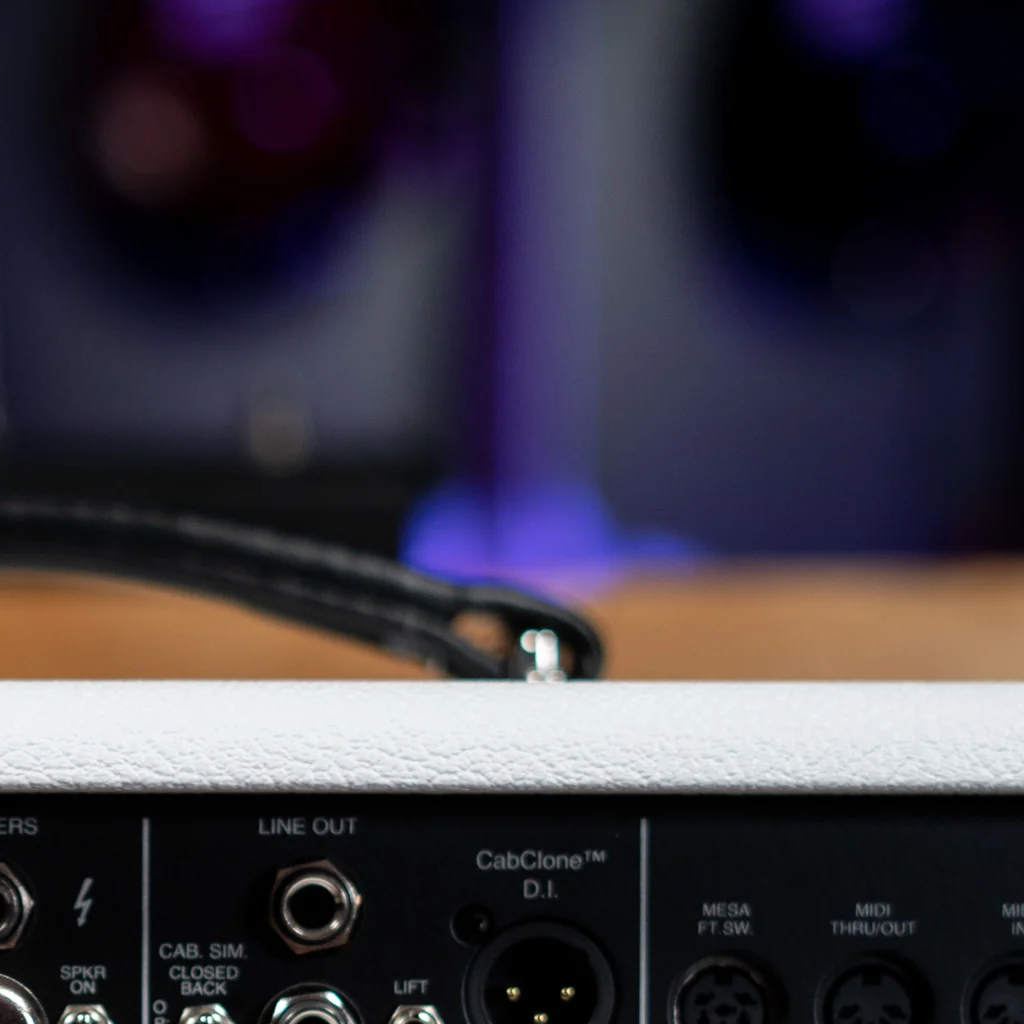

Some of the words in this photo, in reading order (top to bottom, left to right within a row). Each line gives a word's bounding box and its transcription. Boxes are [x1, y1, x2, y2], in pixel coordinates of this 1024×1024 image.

[258, 817, 306, 836] LINE
[311, 817, 357, 836] OUT
[523, 878, 558, 900] D.I.
[702, 902, 751, 918] MESA
[855, 903, 891, 918] MIDI
[831, 920, 916, 937] THRU/OUT
[158, 942, 203, 960] CAB.
[208, 942, 247, 960] SIM.
[60, 965, 107, 981] SPKR
[168, 964, 240, 982] CLOSED
[69, 980, 97, 995] ON
[180, 980, 227, 997] BACK
[393, 979, 429, 995] LIFT
